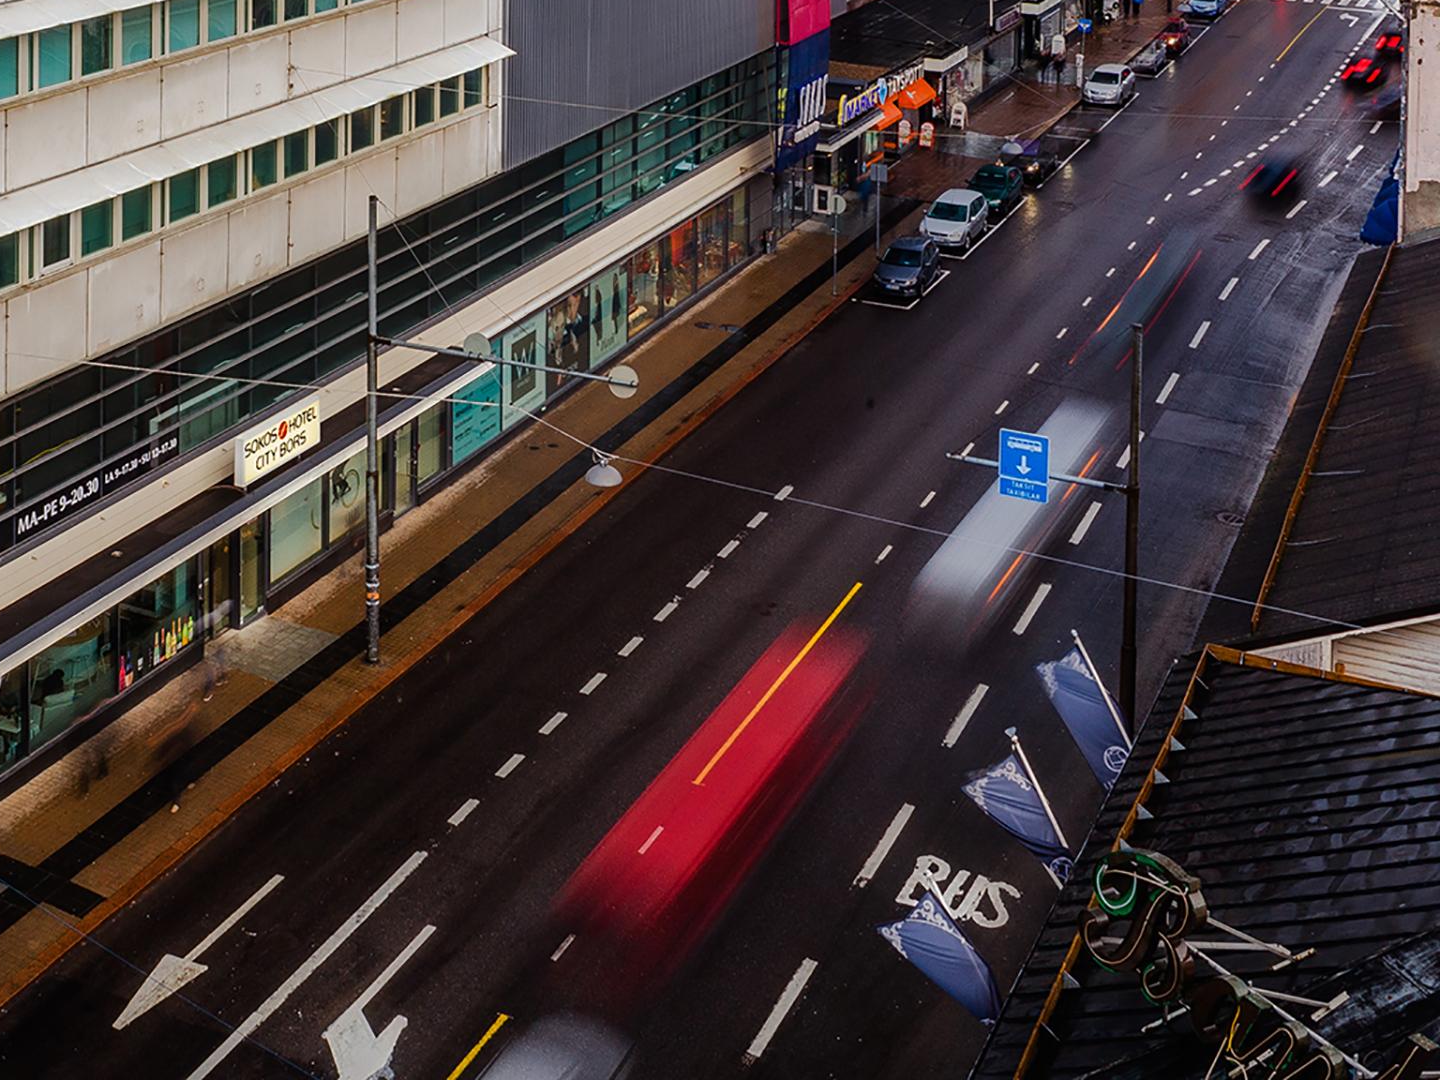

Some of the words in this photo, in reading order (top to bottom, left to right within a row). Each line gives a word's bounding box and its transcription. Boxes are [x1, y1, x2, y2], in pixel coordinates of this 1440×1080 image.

[244, 427, 278, 458] SOKOS
[289, 406, 317, 432] HOTEL
[256, 447, 277, 471] CITY
